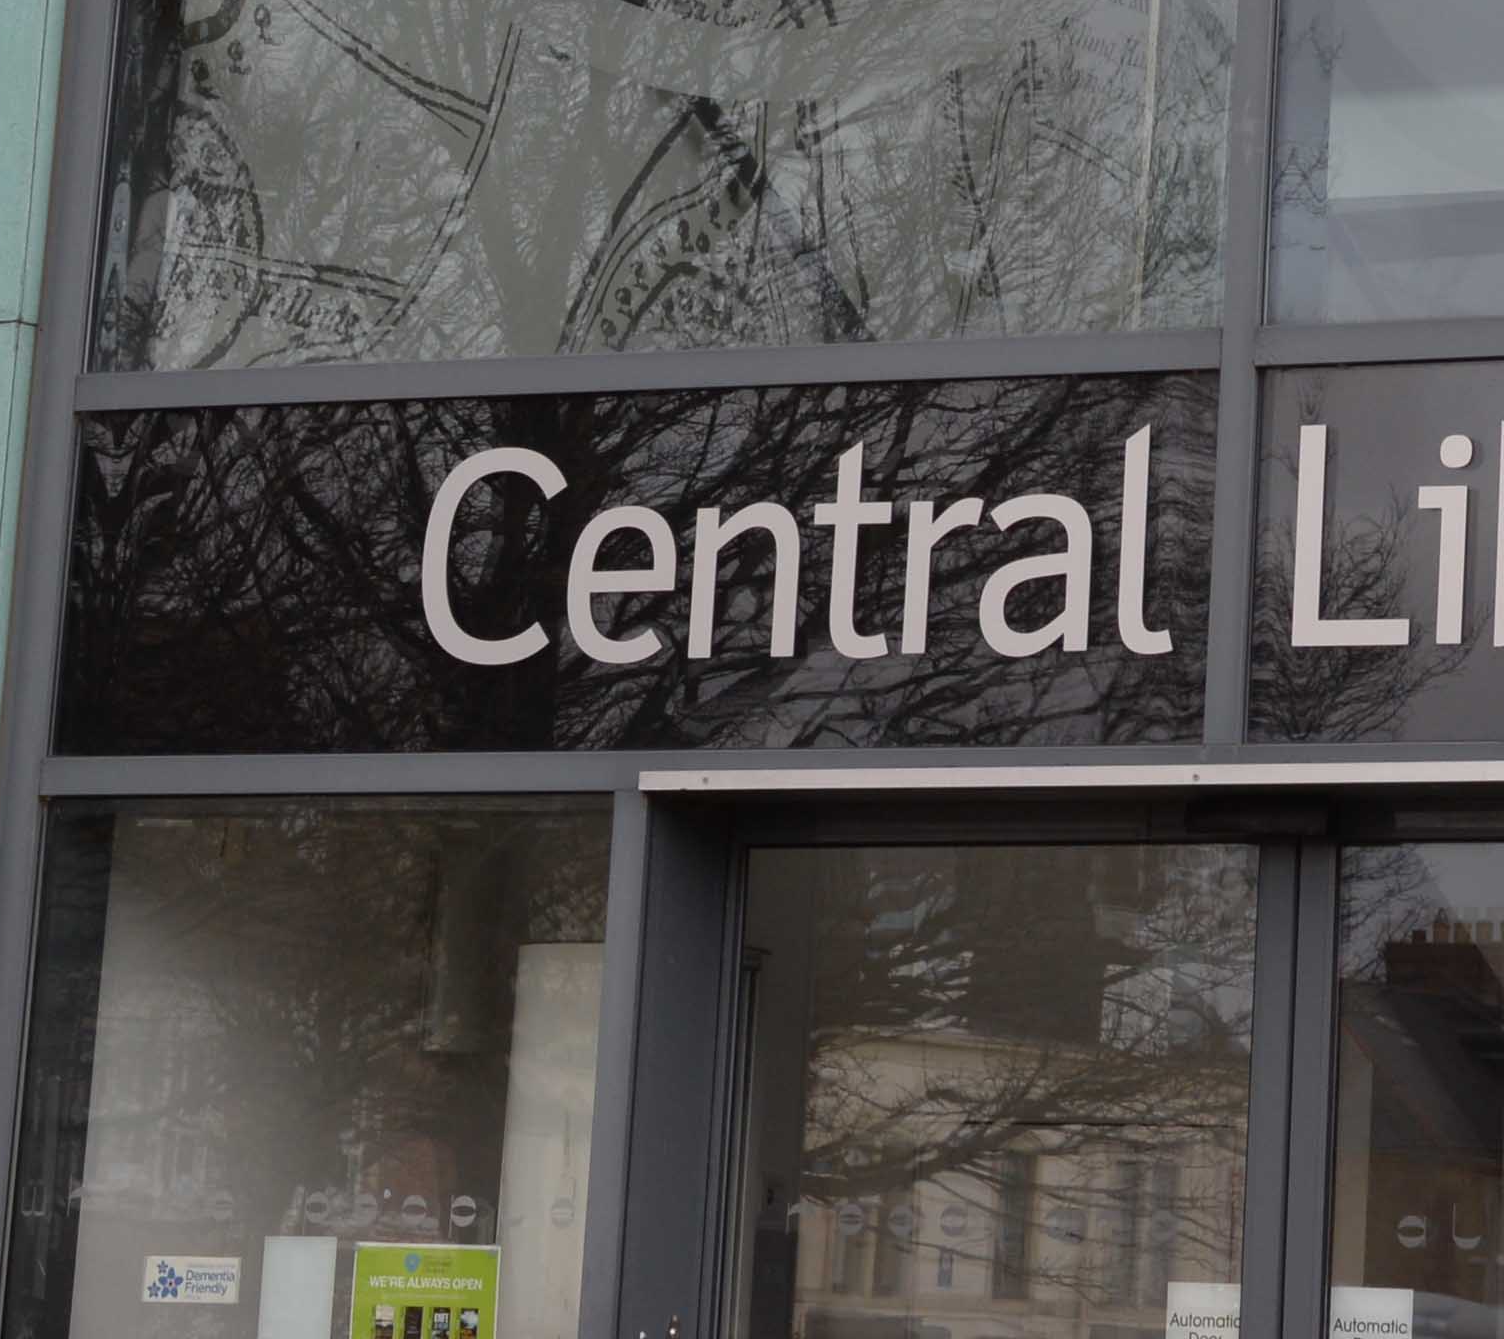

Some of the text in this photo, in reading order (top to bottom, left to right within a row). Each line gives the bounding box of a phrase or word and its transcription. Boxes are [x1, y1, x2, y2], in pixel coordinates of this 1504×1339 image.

[419, 421, 1176, 665] Central
[185, 1269, 235, 1283] Dementia
[369, 1274, 483, 1292] WE'RE ALWAYS OPEN
[184, 1281, 228, 1297] Friendly
[1169, 1312, 1240, 1329] Automatic
[1332, 1317, 1408, 1335] Automatic
